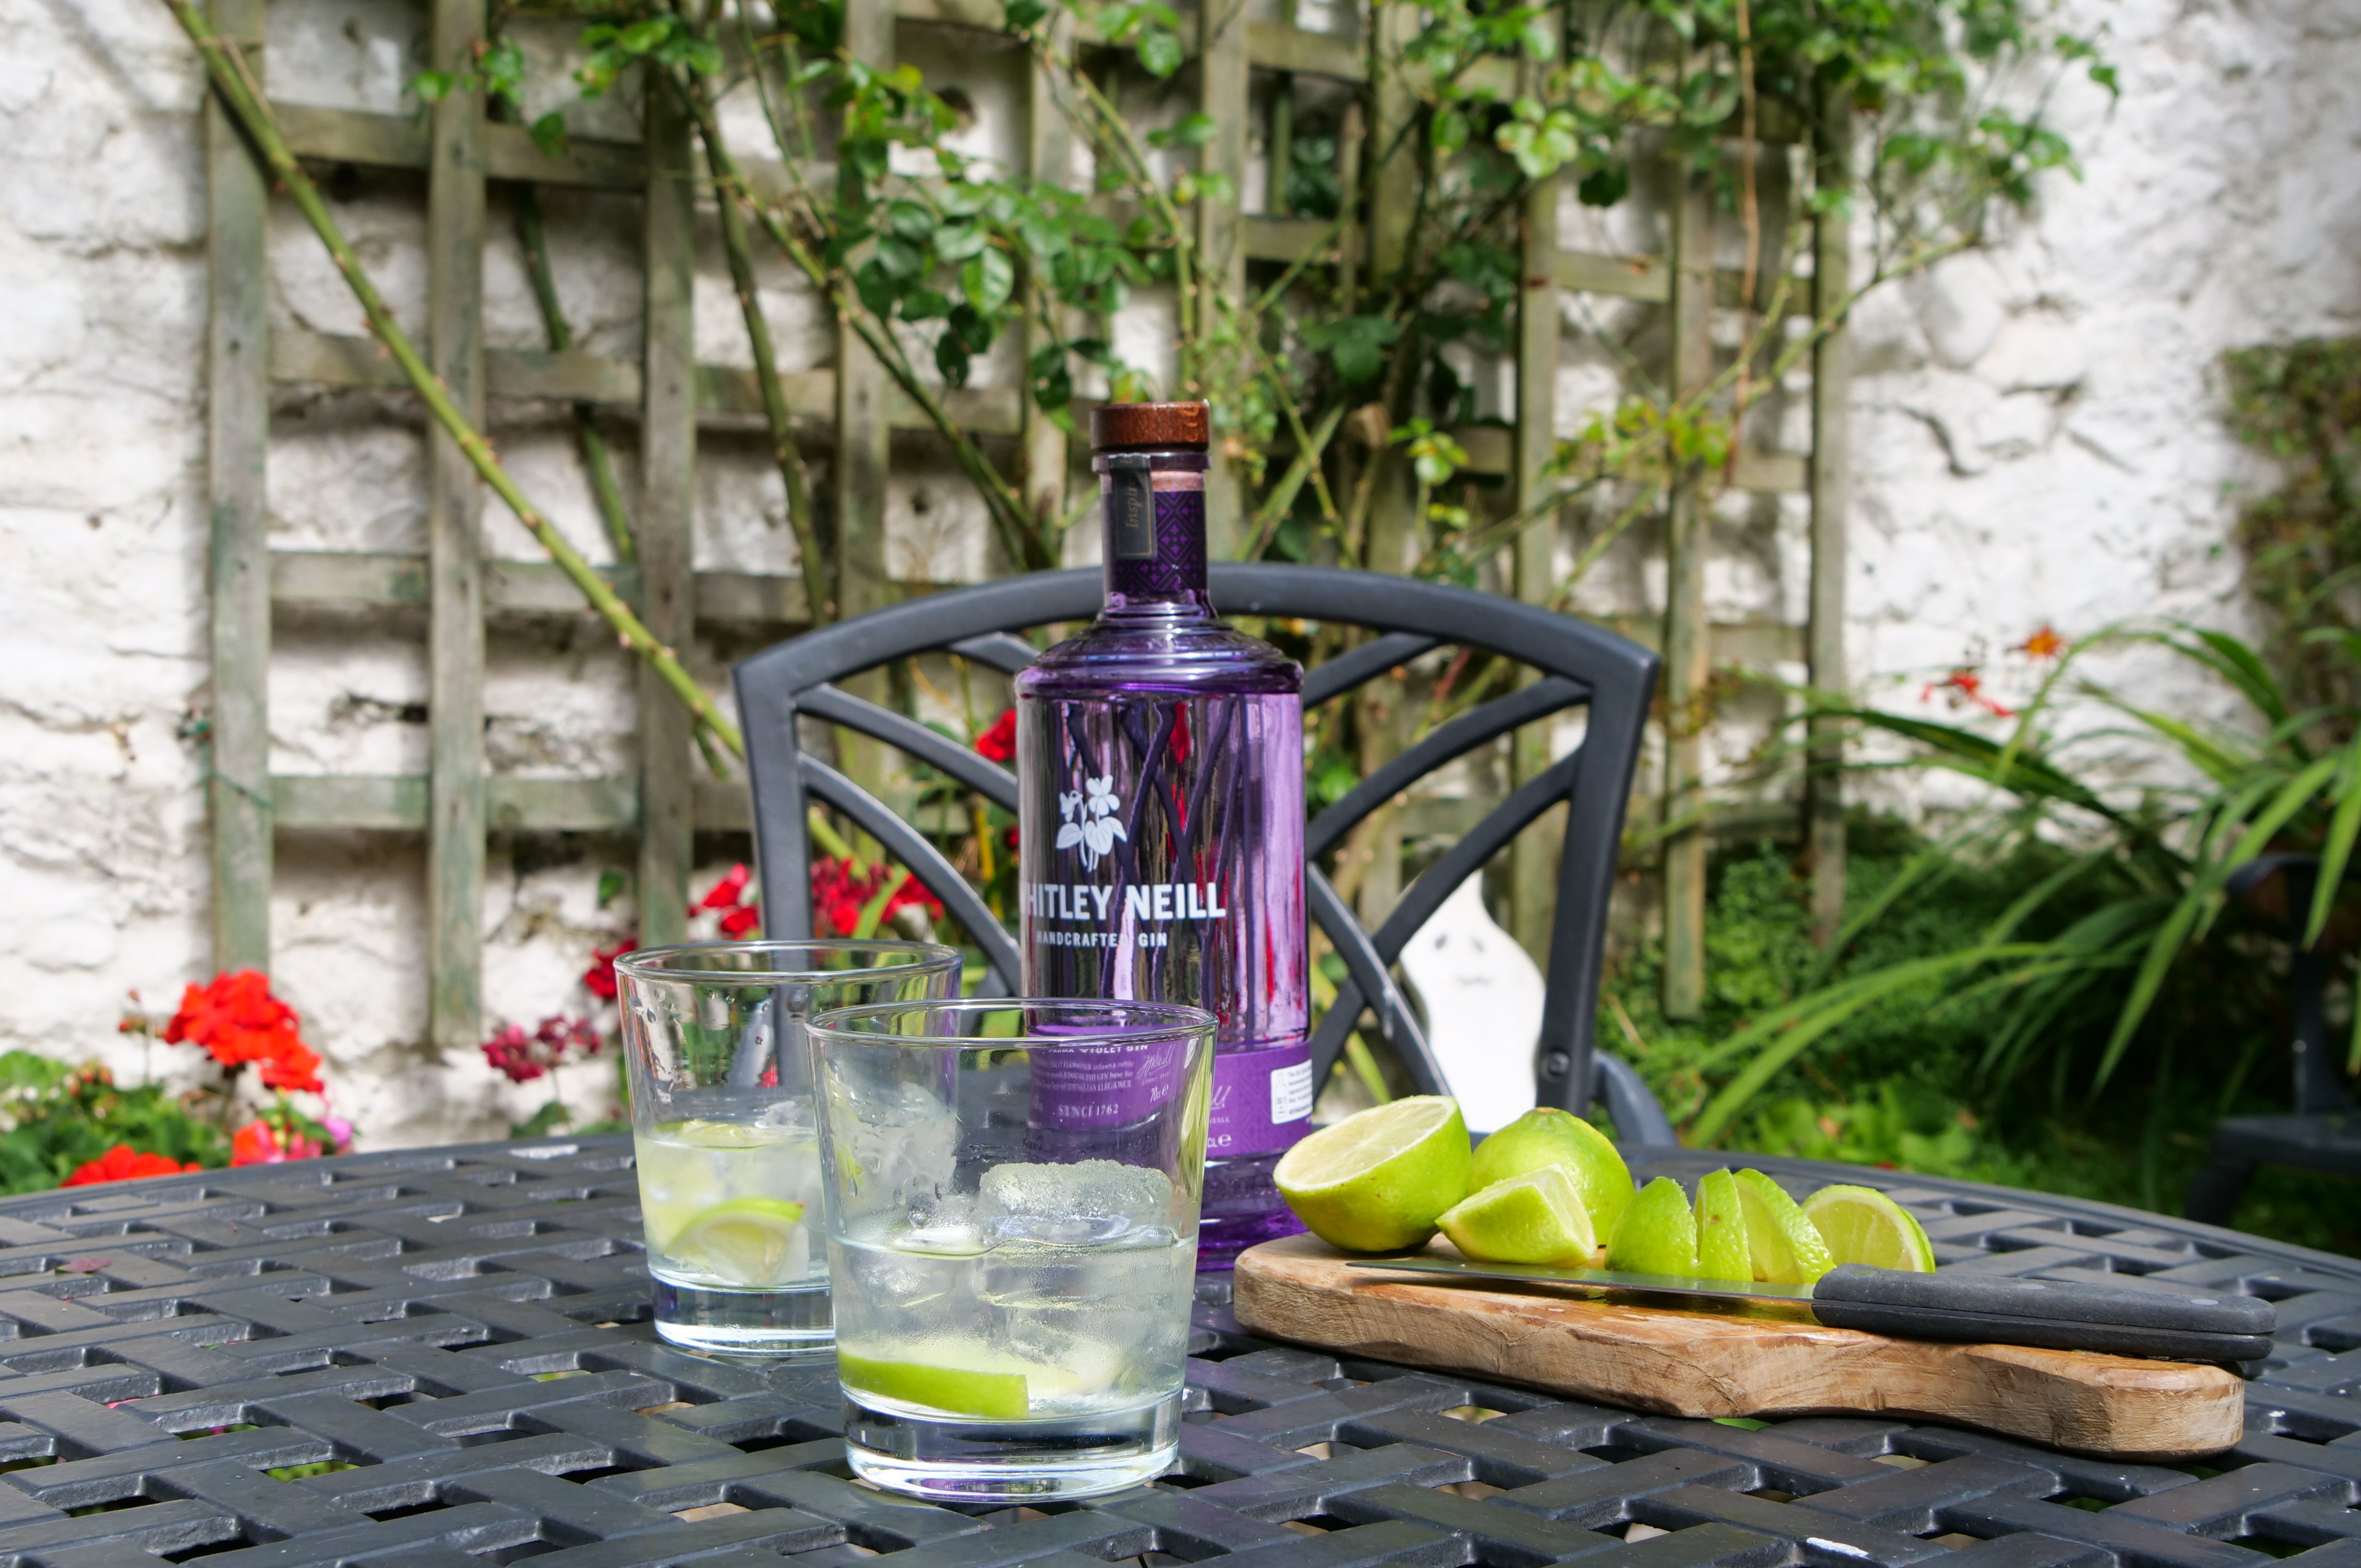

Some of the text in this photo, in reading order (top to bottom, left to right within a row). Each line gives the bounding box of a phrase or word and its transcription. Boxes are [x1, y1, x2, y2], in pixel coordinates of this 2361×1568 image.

[1125, 477, 1142, 529] Inspir
[1026, 881, 1226, 921] HITLEY NEILL
[1037, 930, 1167, 948] HANDCRAFTED GIN
